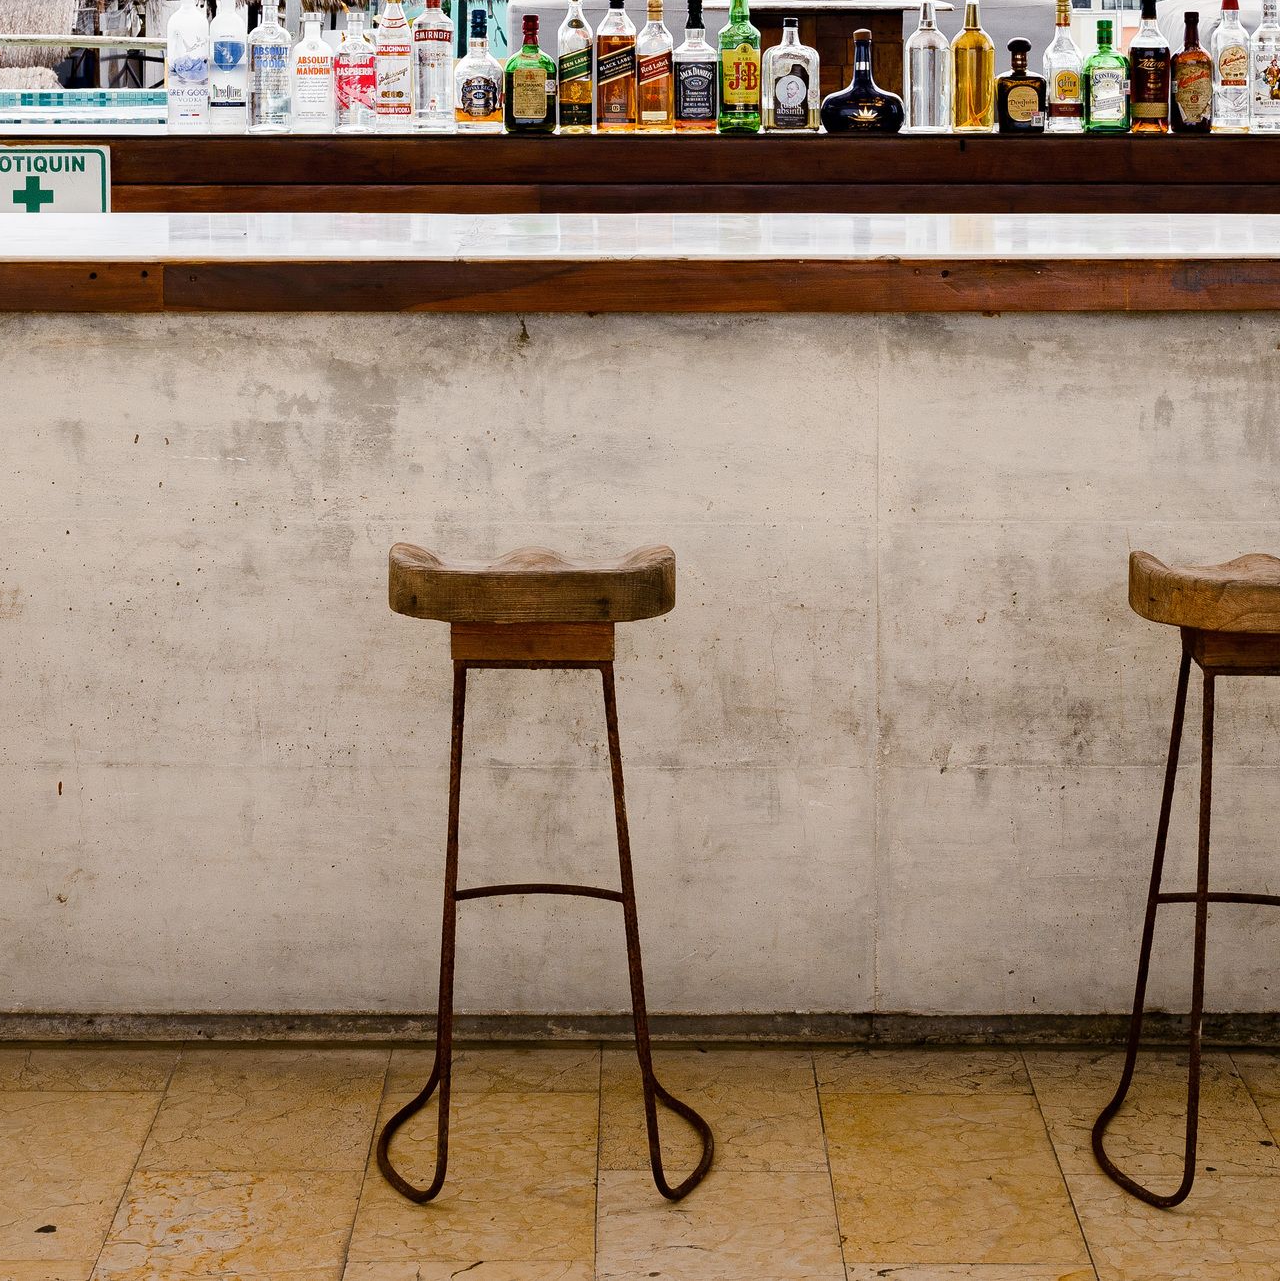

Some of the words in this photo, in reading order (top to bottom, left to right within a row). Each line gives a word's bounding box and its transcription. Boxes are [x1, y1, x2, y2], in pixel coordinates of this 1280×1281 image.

[415, 30, 450, 40] SMIRNOFF
[254, 46, 288, 56] ABSOLUT
[256, 59, 286, 68] VODKA
[297, 56, 329, 64] ABSOLUT
[599, 61, 617, 71] BLACK
[640, 64, 653, 73] Red
[652, 58, 669, 69] Label
[296, 67, 331, 75] MANDRIN
[680, 69, 693, 80] JACK
[728, 61, 758, 90] J&B
